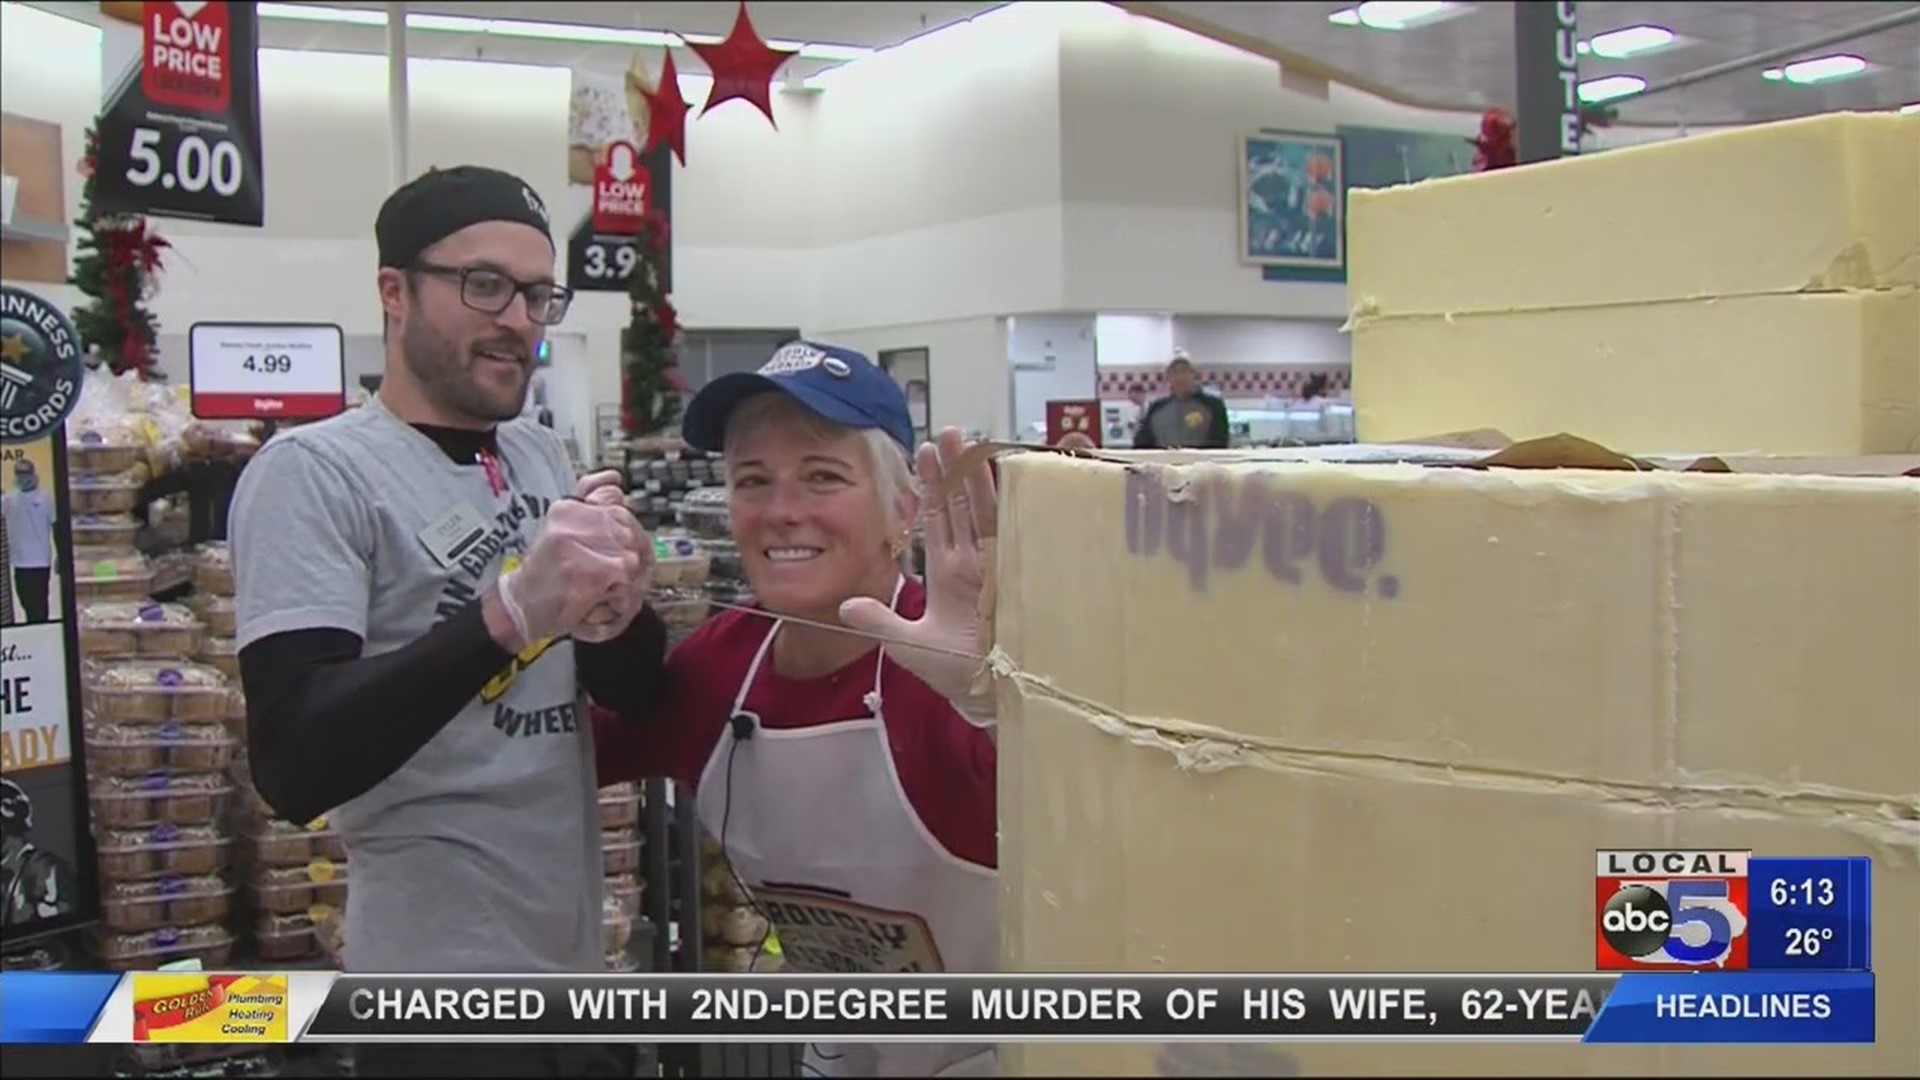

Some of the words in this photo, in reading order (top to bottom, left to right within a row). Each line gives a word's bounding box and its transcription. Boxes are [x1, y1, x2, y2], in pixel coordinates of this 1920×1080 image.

[153, 13, 222, 53] LOW
[153, 45, 222, 81] PRICE
[126, 127, 242, 196] 5.00
[599, 181, 645, 201] LOW
[599, 200, 644, 215] PRICE
[584, 244, 639, 278] 3.9
[242, 354, 292, 373] 4.99
